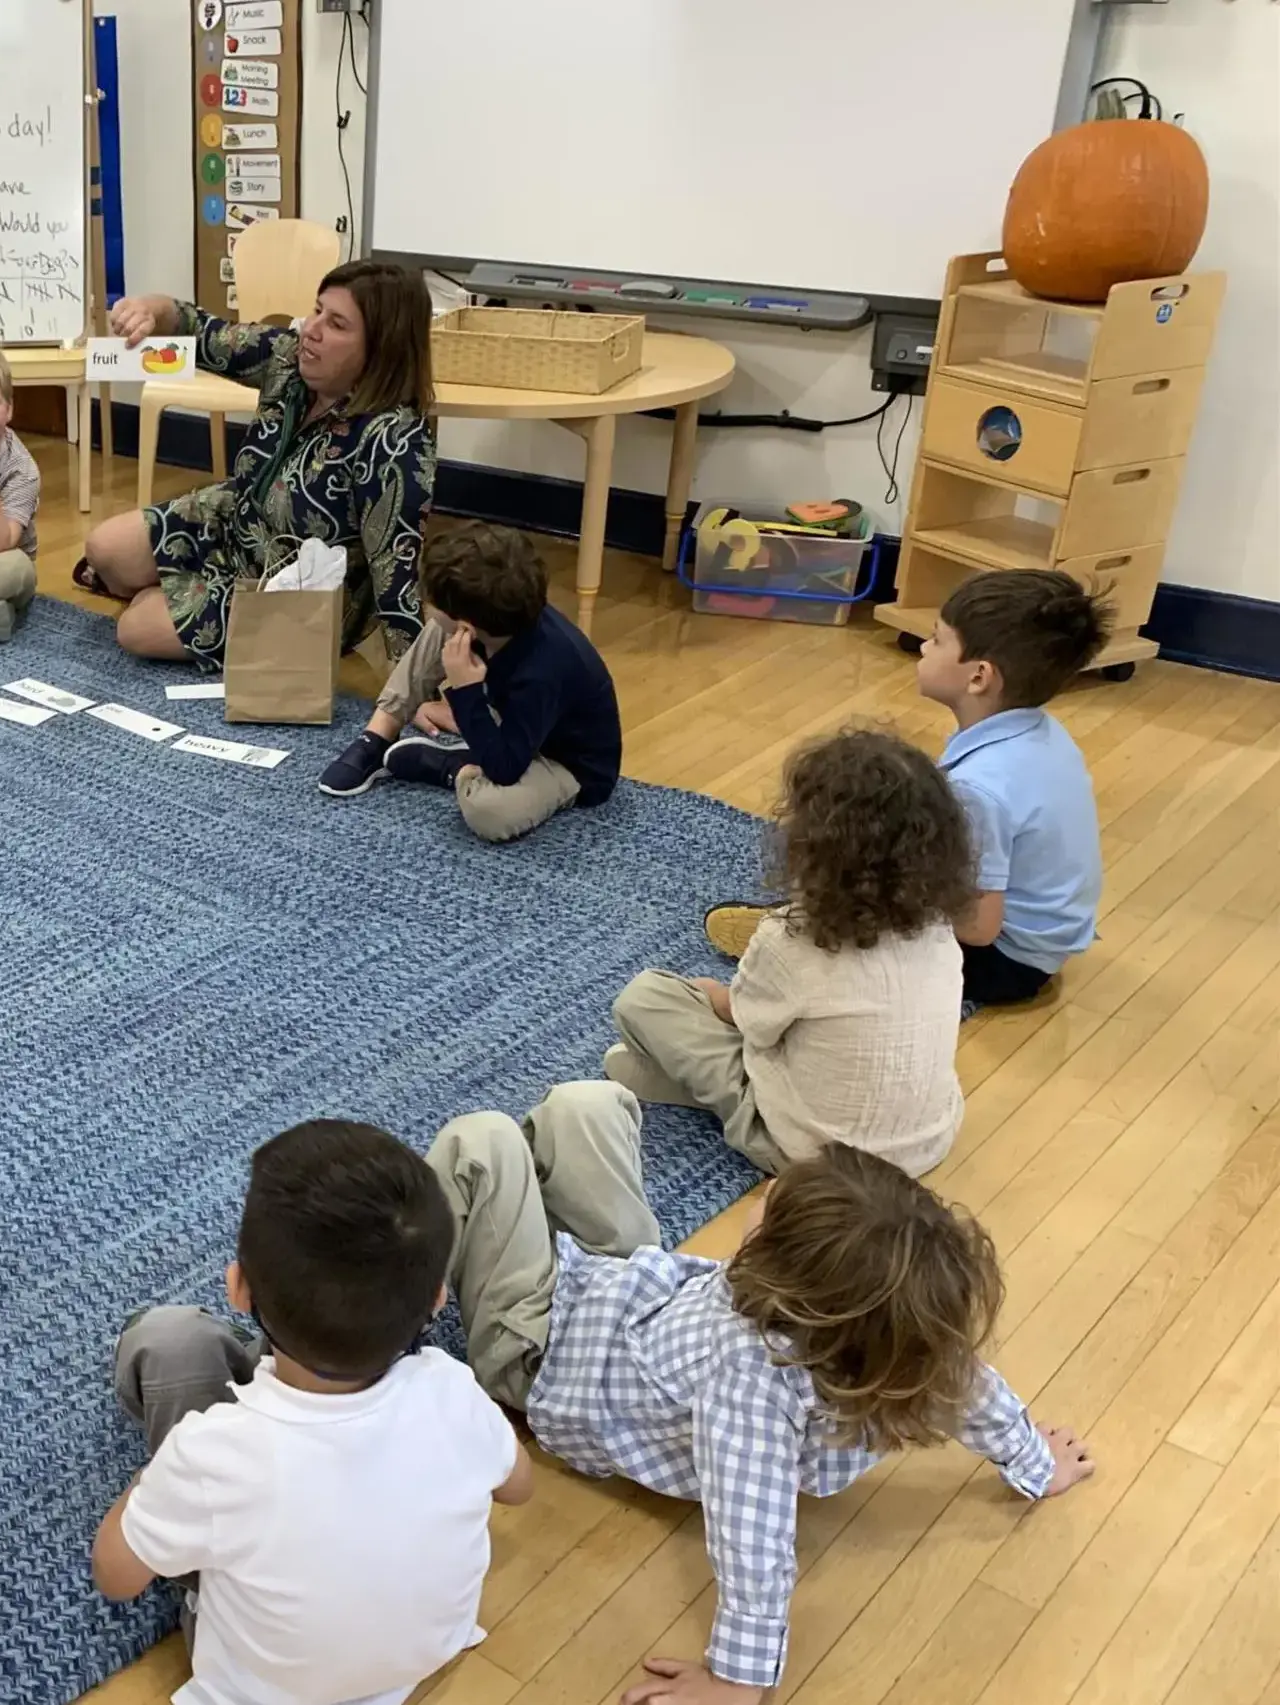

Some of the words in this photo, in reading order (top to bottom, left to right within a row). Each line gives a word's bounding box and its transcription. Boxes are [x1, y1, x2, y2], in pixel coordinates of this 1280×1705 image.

[242, 35, 267, 45] Snack
[8, 105, 53, 147] day!
[242, 129, 267, 139] Lunch
[246, 182, 266, 194] Story
[46, 221, 69, 240] you
[92, 352, 118, 365] fruit
